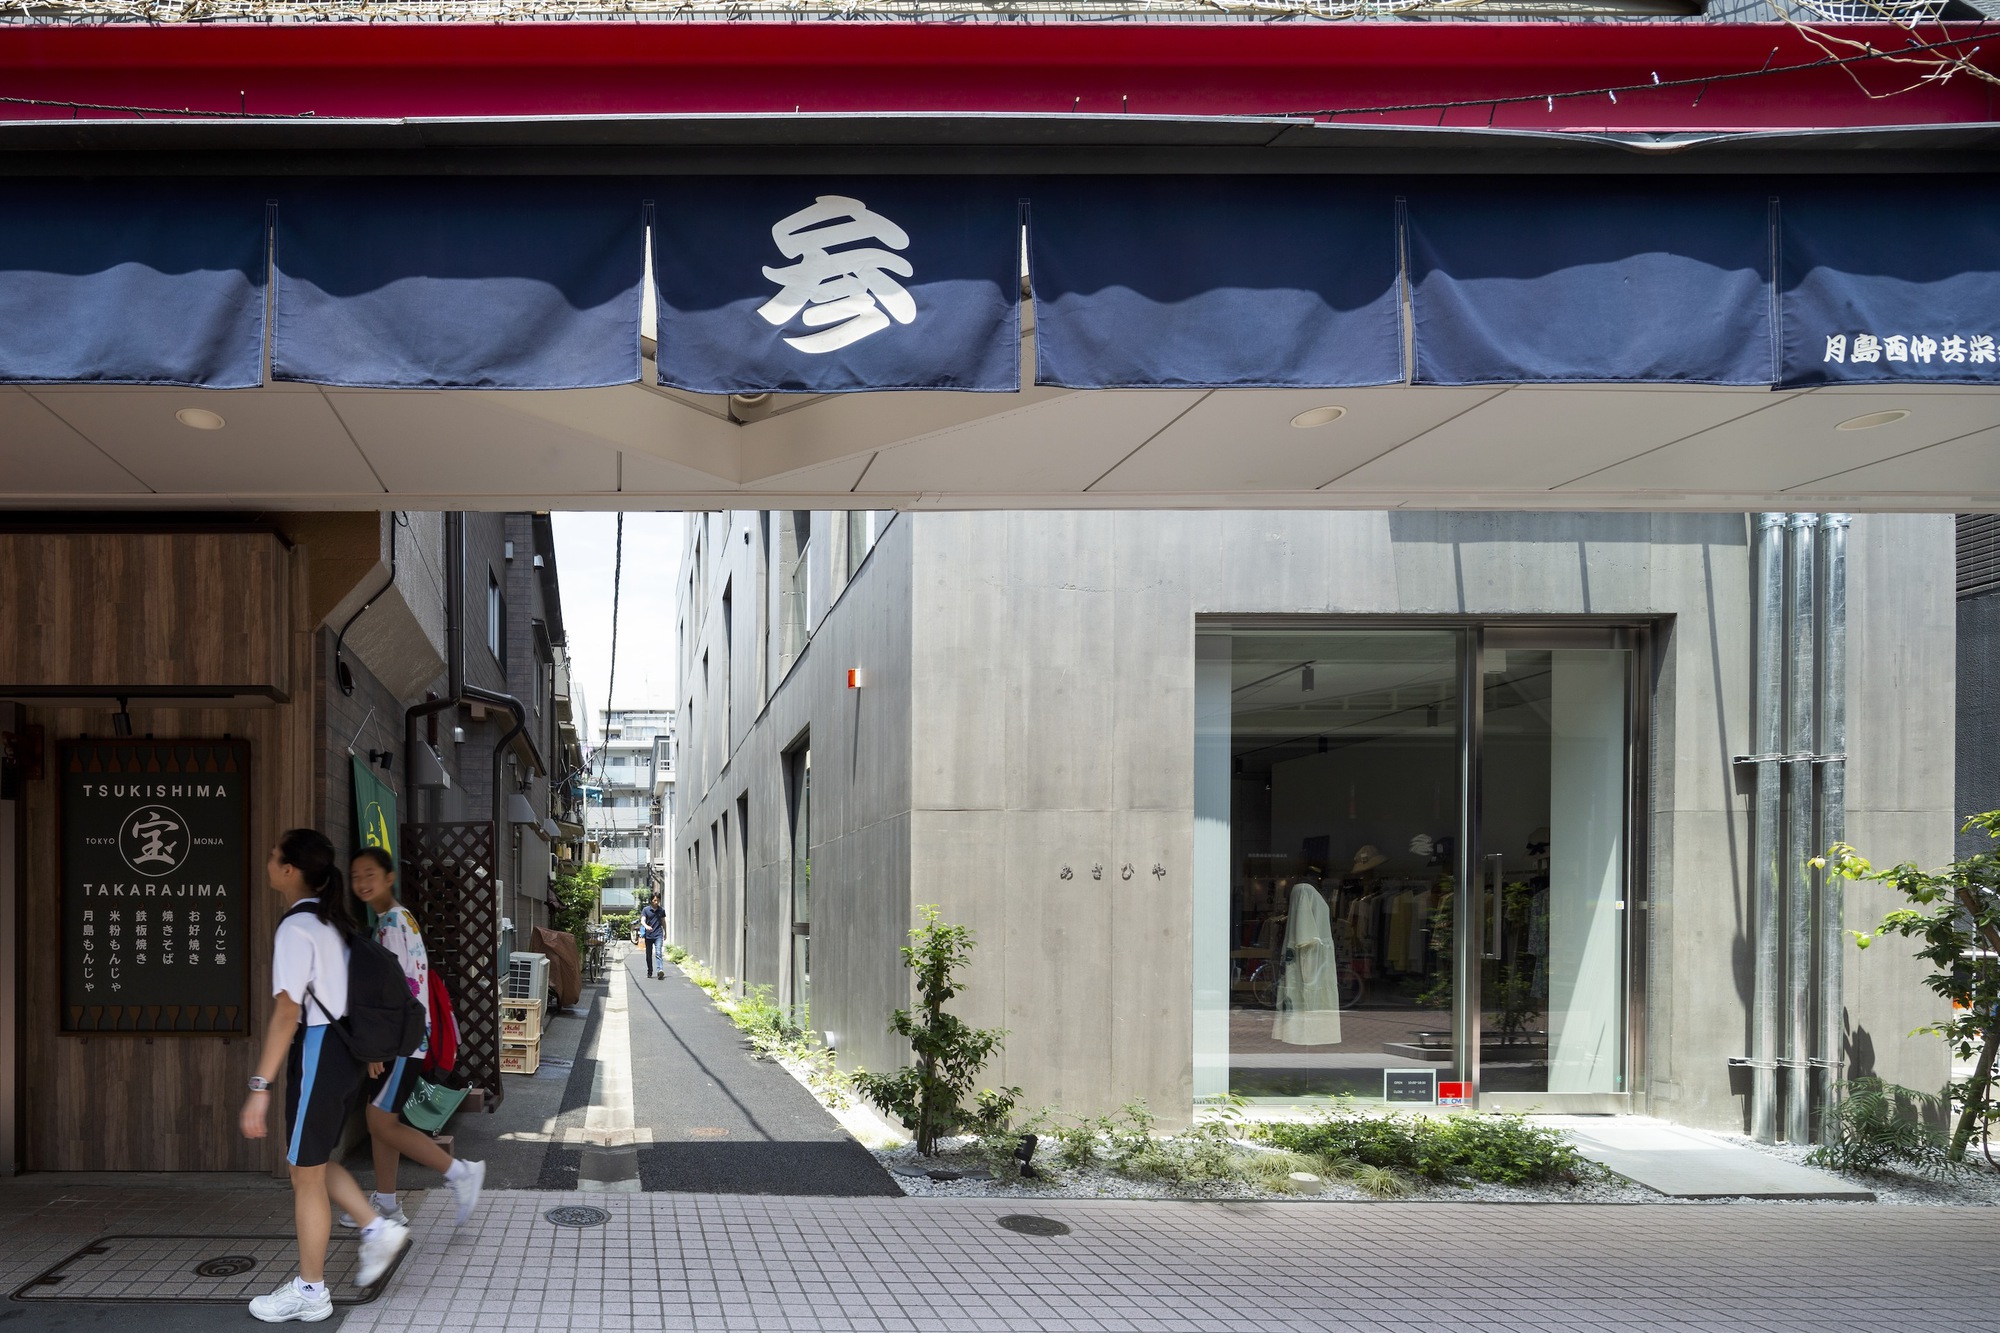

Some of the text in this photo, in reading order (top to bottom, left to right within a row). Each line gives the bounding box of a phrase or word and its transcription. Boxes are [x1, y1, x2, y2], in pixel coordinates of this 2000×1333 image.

[1823, 333, 2000, 364] 月島西仲共栄
[83, 785, 227, 797] TSUKISHIMA
[83, 884, 227, 897] TAKARAJIMA
[83, 910, 95, 992] 月島もんじゃ
[109, 910, 121, 992] 米粉もんじゃ
[135, 910, 147, 965] 鉄板焼き
[162, 910, 174, 965] 焼きそば
[188, 910, 200, 965] お好焼き
[214, 910, 227, 965] あんこ巻
